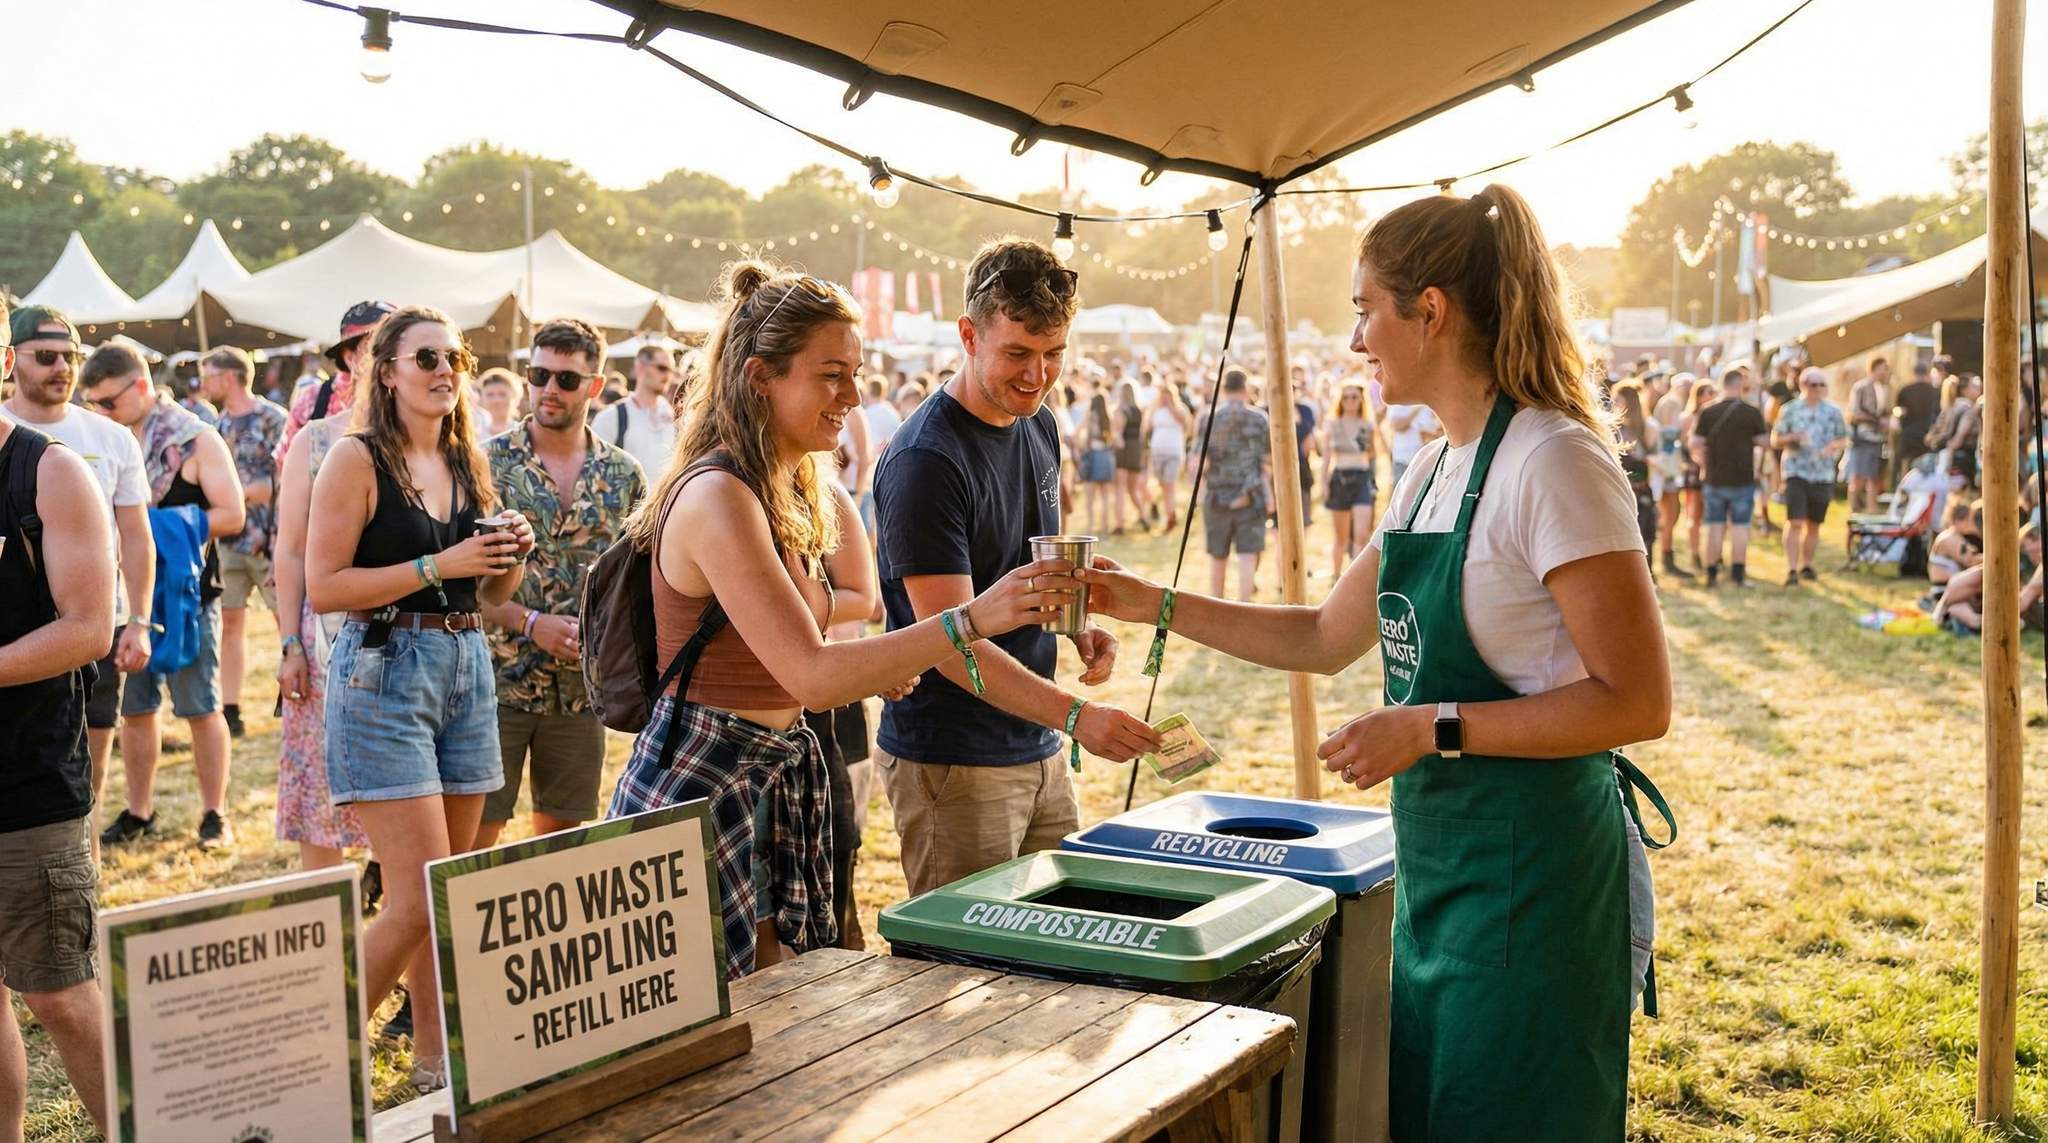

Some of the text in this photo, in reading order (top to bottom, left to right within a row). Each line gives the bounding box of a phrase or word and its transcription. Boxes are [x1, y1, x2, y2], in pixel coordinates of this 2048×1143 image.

[1383, 637, 1418, 666] WASTE
[1151, 831, 1288, 866] RECYCLING
[476, 849, 688, 954] ZERO WASTE
[962, 902, 1167, 950] COMPOSTABLE
[147, 921, 326, 985] ALLERGEN INFO
[504, 910, 677, 1006] SAMPLING
[533, 991, 614, 1049] REFILL
[619, 969, 678, 1019] HERE
